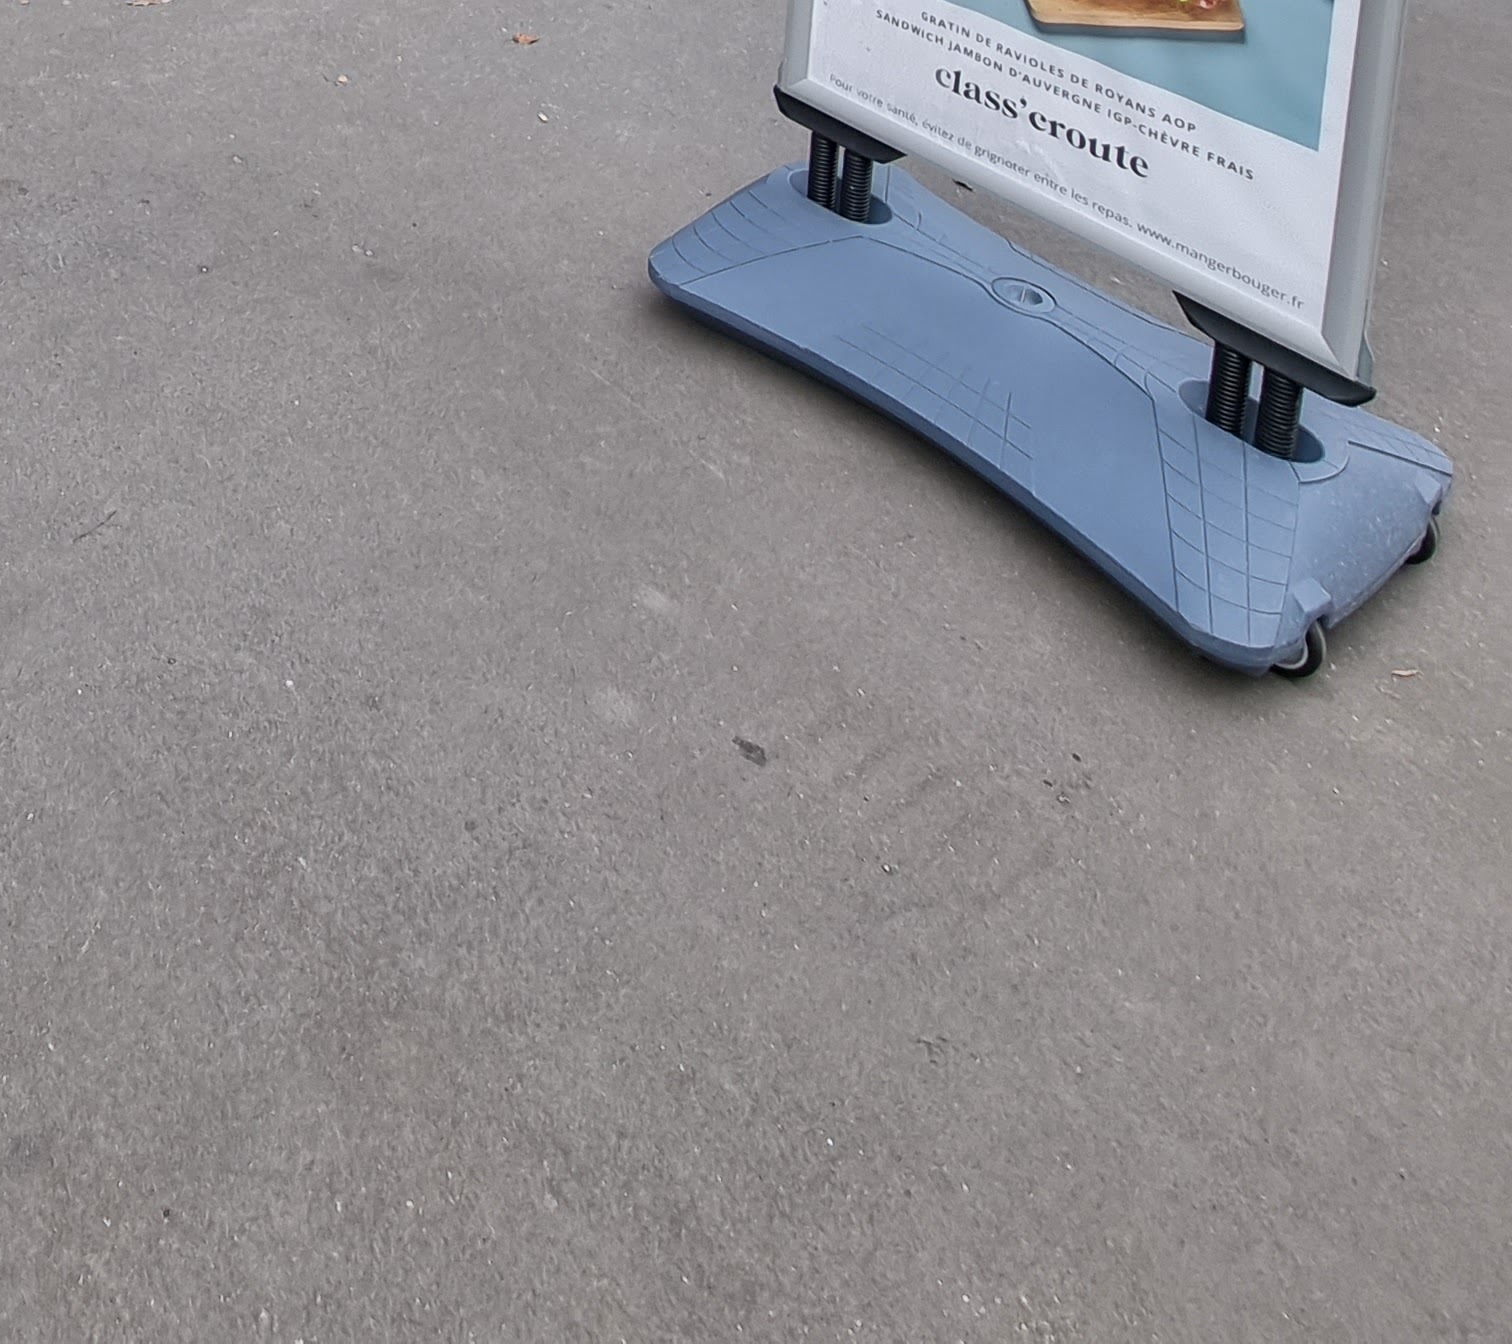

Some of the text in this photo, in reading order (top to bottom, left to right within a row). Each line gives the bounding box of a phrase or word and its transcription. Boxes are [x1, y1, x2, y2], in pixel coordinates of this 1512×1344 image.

[875, 9, 1256, 181] SANDWICH JAMBON D'AUVERGNE IGP-CHÈVRE FRAIS
[920, 11, 1198, 133] GRATIN DE RAVIOLES DE ROYANS AOP
[829, 72, 1305, 311] Pour votre santé, évitez de grignoter entre les repas. www.mangerbouger.fr
